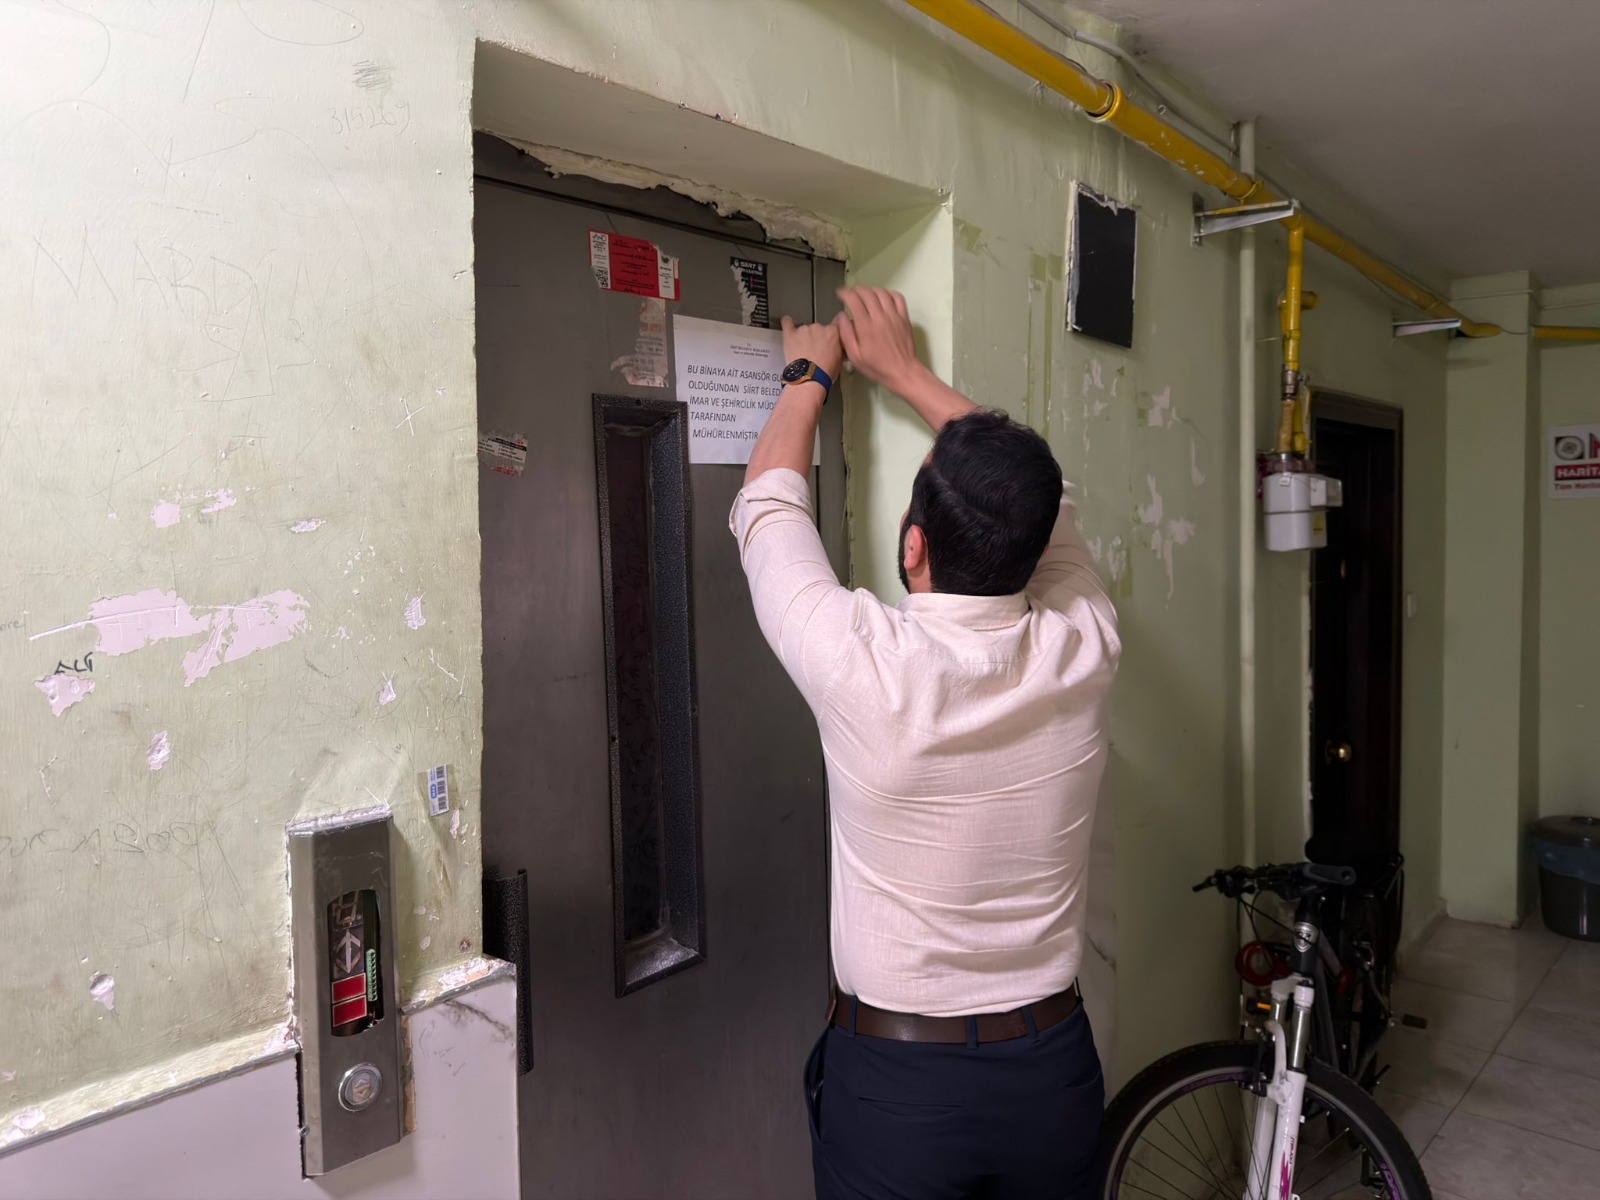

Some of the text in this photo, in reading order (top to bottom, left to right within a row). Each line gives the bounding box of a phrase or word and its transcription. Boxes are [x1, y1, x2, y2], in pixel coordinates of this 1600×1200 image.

[687, 364, 699, 374] BU
[700, 365, 726, 377] BİNAYA
[727, 367, 739, 378] AİT
[740, 370, 771, 381] ASANSÖR
[688, 380, 740, 393] OLDUĞUNDAN
[760, 386, 781, 397] BELED
[689, 393, 710, 406] İMAR
[711, 397, 720, 407] VE
[757, 400, 774, 411] MÜD
[690, 411, 737, 423] TARAFINDAN
